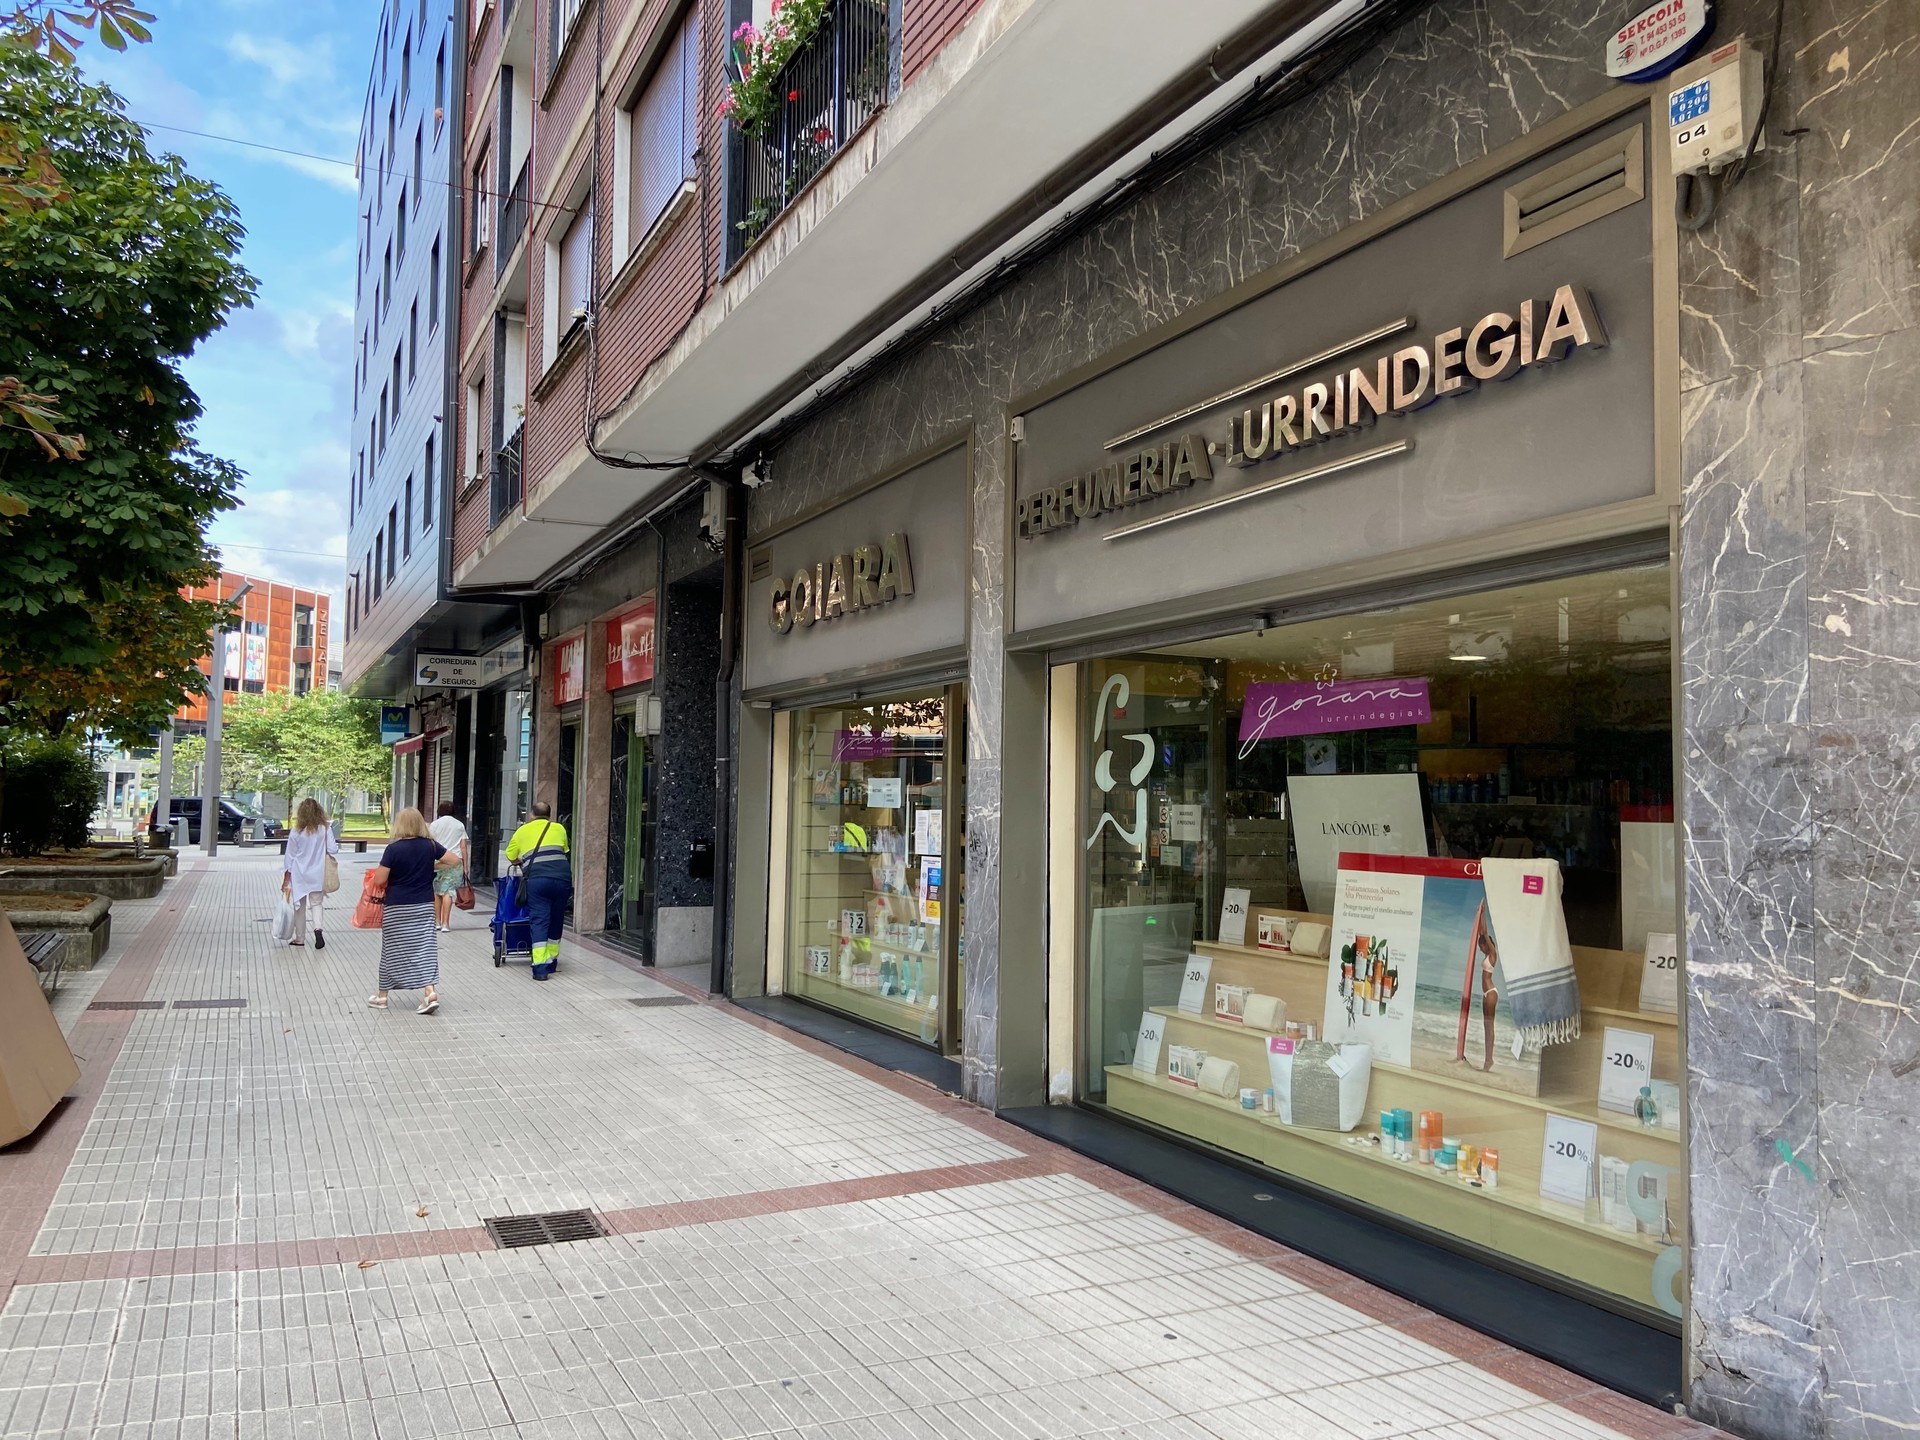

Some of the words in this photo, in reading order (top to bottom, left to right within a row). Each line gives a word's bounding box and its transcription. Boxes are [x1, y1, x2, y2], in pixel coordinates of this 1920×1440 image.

[1617, 0, 1684, 44] SERCOIN
[1647, 30, 1655, 42] 94
[1655, 23, 1667, 36] 453
[1668, 18, 1677, 29] 53
[1678, 12, 1686, 24] 53
[1679, 93, 1708, 111] 0206
[1697, 105, 1705, 114] C
[1016, 433, 1212, 539] PERFUMERIA
[1226, 284, 1606, 466] LURRINDEGIA
[768, 532, 914, 634] GOIARA
[429, 657, 477, 666] CORREDURIA
[441, 678, 477, 686] SEGUROS
[1320, 708, 1424, 724] lurrindegiak
[1321, 820, 1380, 837] LANCÔME
[1606, 1052, 1645, 1072] -20%
[1549, 1141, 1588, 1162] -20%
